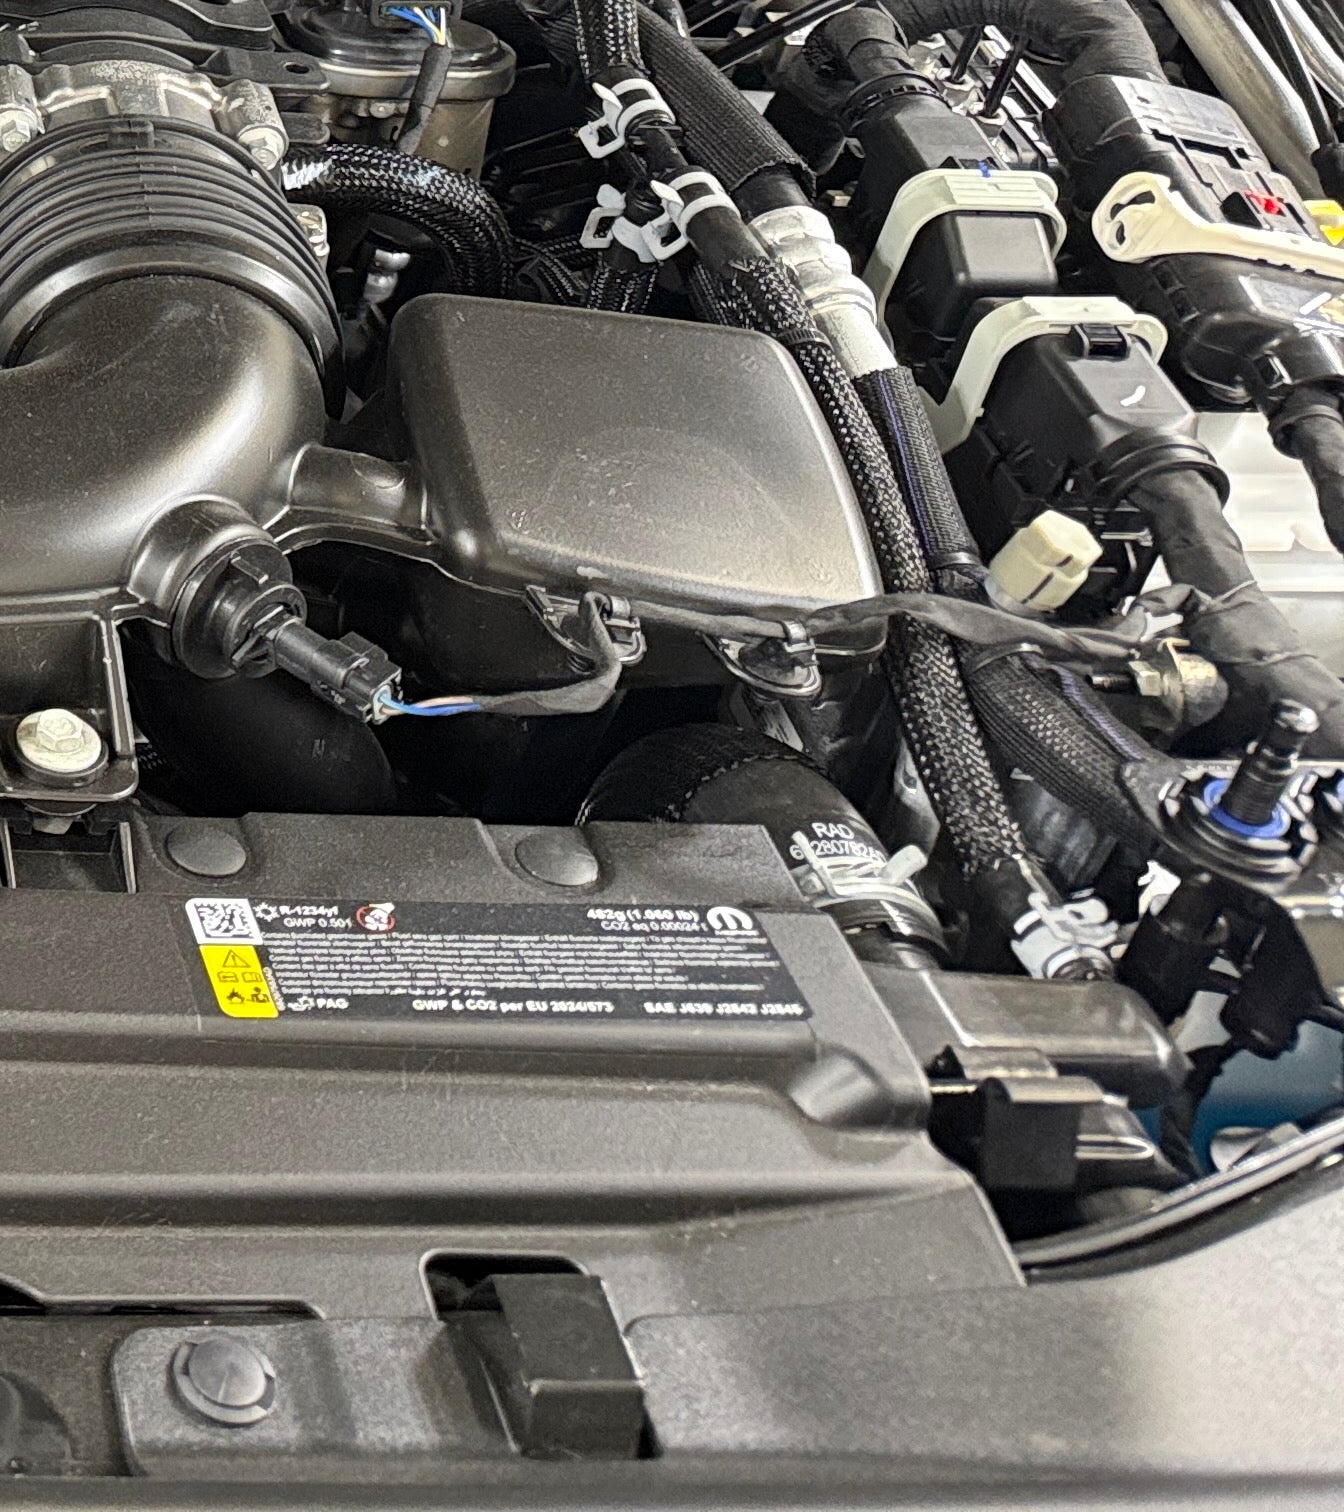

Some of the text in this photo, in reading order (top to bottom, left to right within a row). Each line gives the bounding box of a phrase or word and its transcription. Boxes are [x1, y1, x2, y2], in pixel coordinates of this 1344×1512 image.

[811, 822, 855, 839] RAD
[283, 917, 316, 928] GWP
[316, 998, 350, 1010] PAG
[412, 999, 448, 1011] GWP
[465, 999, 498, 1011] CO2
[500, 1001, 524, 1013] per
[525, 1000, 549, 1012] EU
[644, 1002, 677, 1014] SAE
